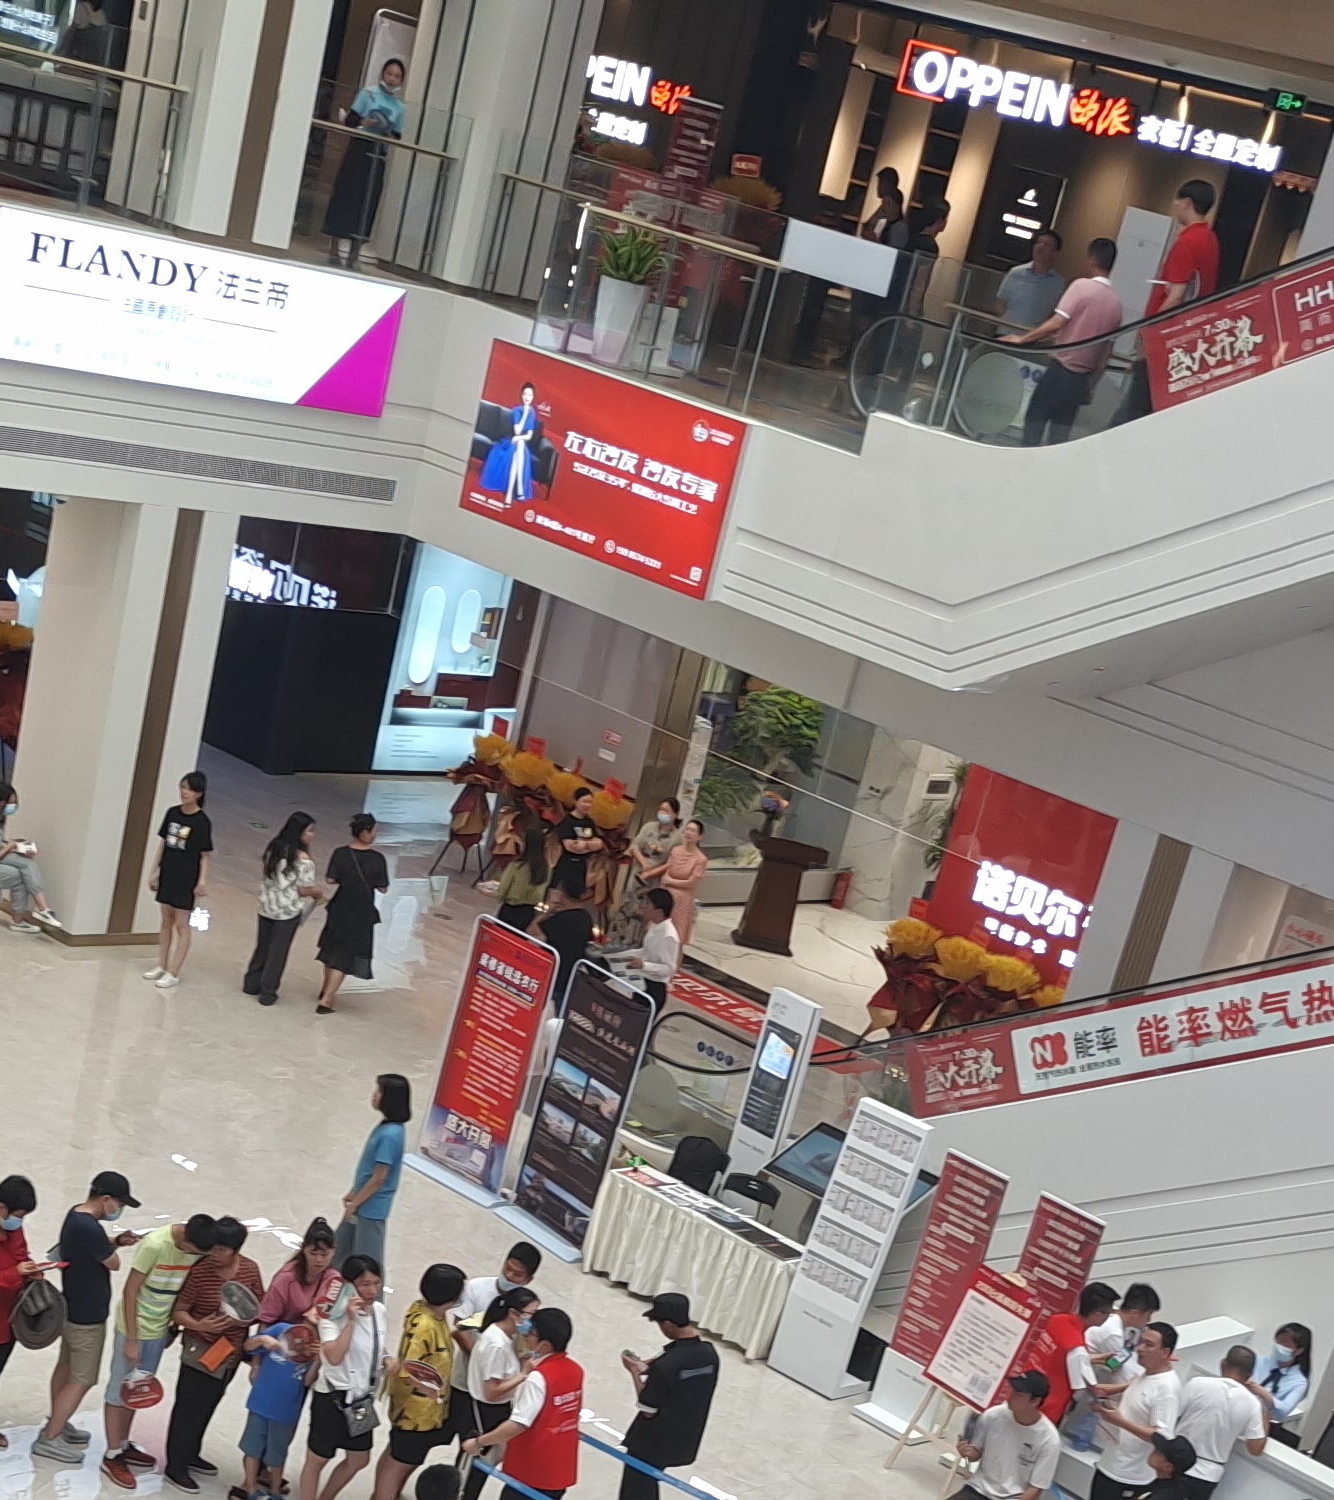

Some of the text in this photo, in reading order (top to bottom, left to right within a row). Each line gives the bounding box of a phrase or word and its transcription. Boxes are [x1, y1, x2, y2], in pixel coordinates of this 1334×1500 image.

[911, 50, 1071, 127] OPPEIN
[1069, 88, 1134, 136] 欧派
[27, 232, 289, 309] FLANDY 法兰帝
[1167, 315, 1264, 381] 盛大开幕
[972, 861, 1094, 938] 诺贝尔
[1073, 1025, 1119, 1060] 能率
